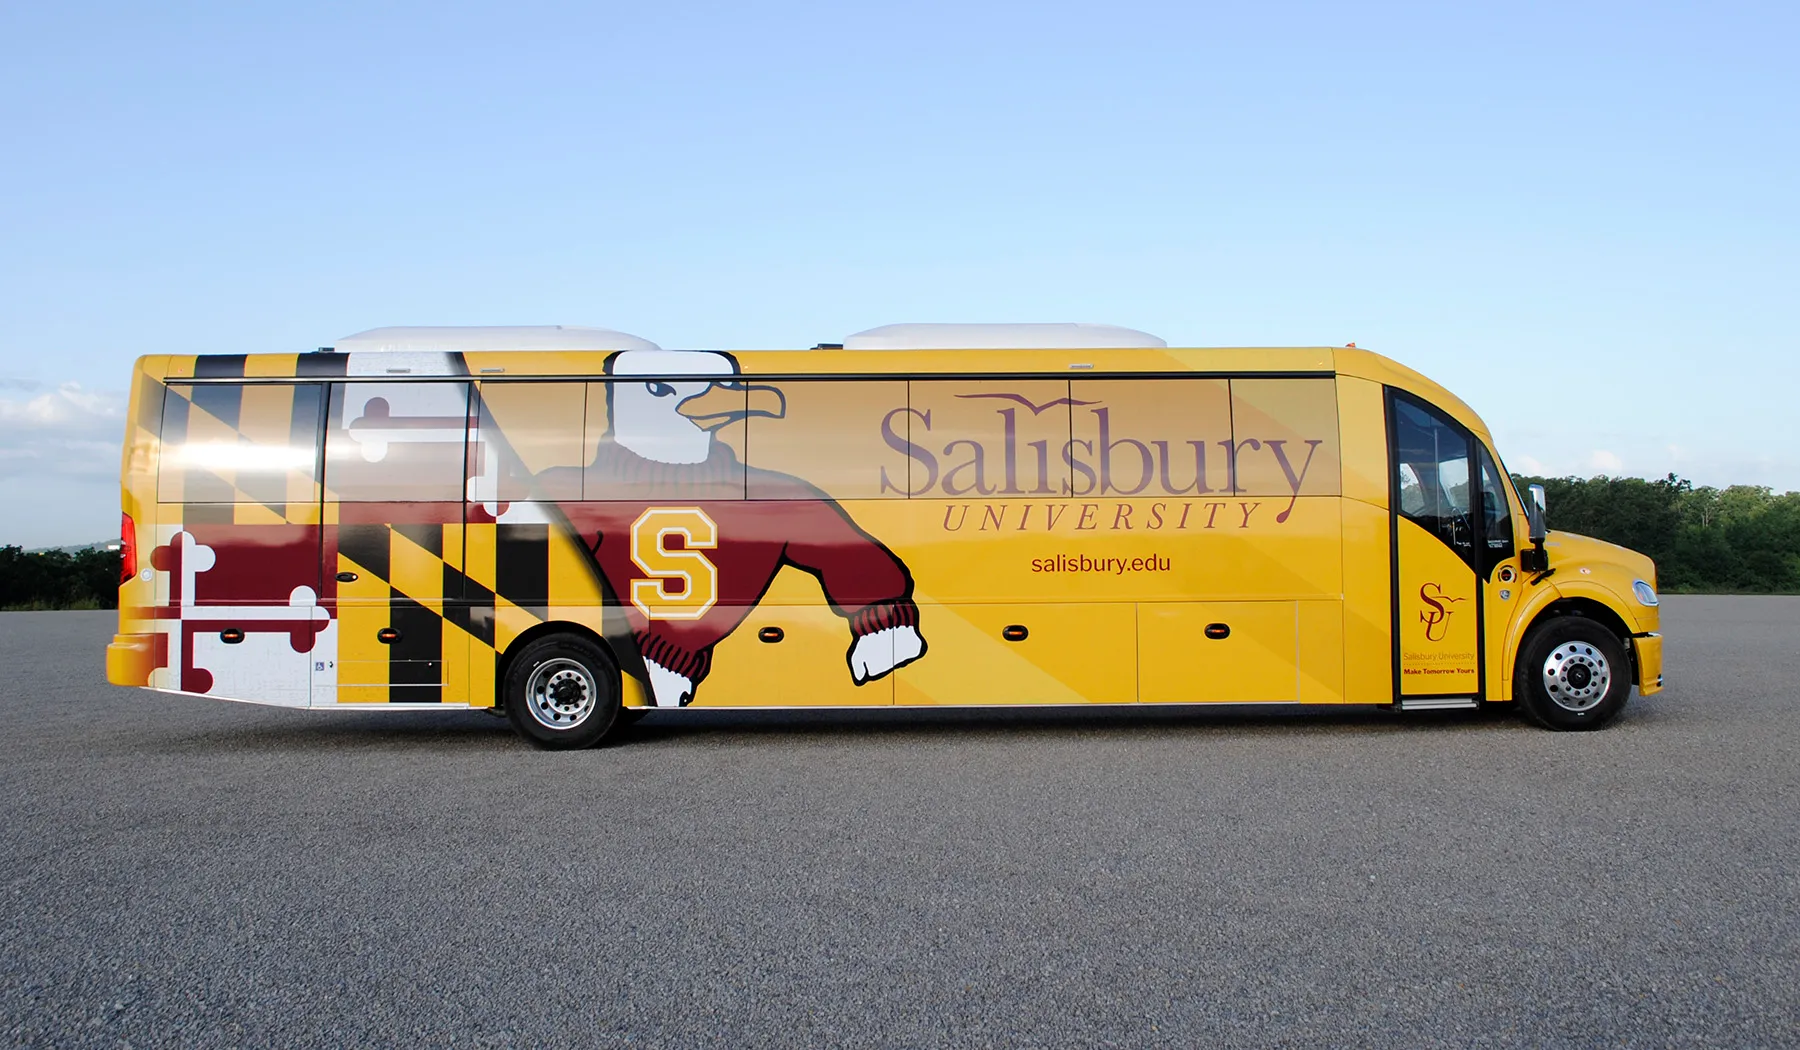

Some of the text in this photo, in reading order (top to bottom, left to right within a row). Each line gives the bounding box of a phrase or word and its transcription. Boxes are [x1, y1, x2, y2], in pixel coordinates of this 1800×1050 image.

[880, 407, 1323, 524] Salisbury
[942, 502, 1262, 532] UNIVERSITY
[630, 506, 718, 620] S
[1031, 553, 1171, 575] salisbury.edu
[1403, 650, 1475, 661] Salisbury University
